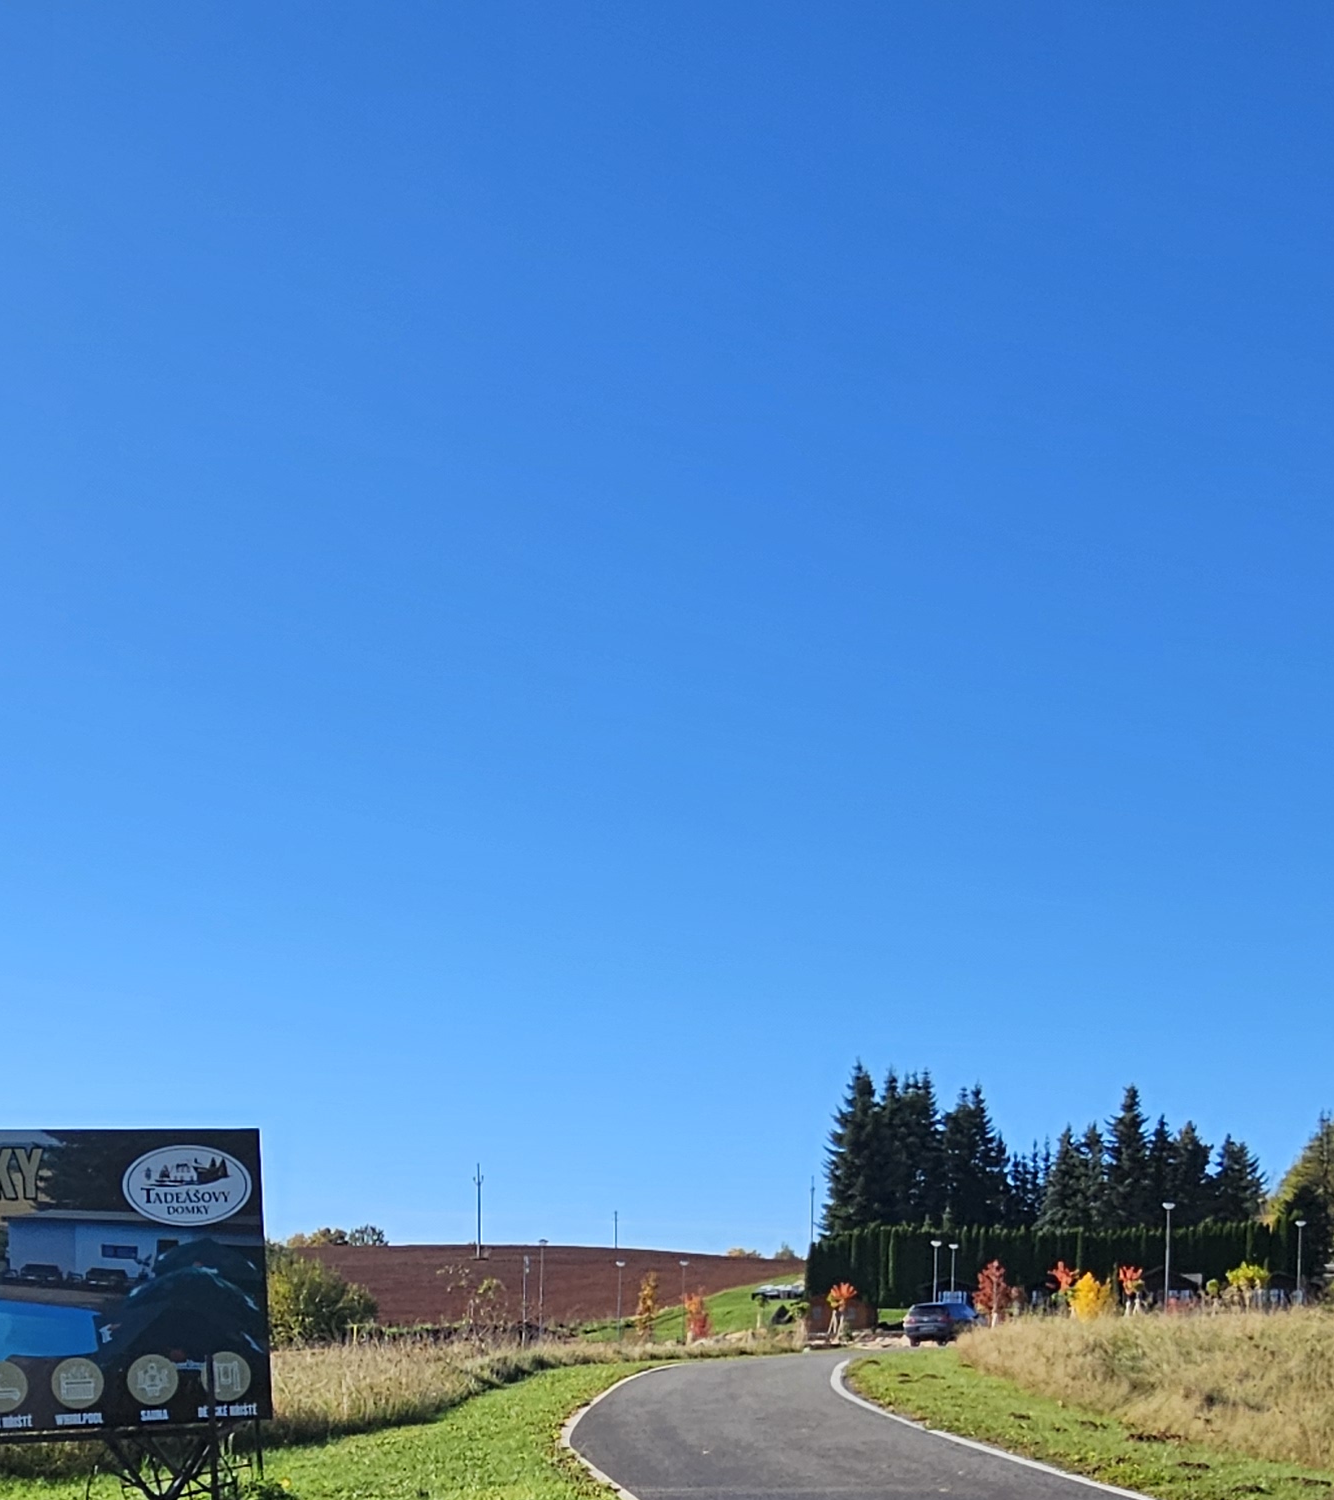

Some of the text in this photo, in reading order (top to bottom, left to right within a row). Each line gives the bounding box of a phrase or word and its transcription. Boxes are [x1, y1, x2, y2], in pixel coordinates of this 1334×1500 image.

[167, 1205, 210, 1215] DOMKY
[54, 1412, 104, 1426] WHIRLPOOL
[140, 1409, 169, 1422] SAUNA
